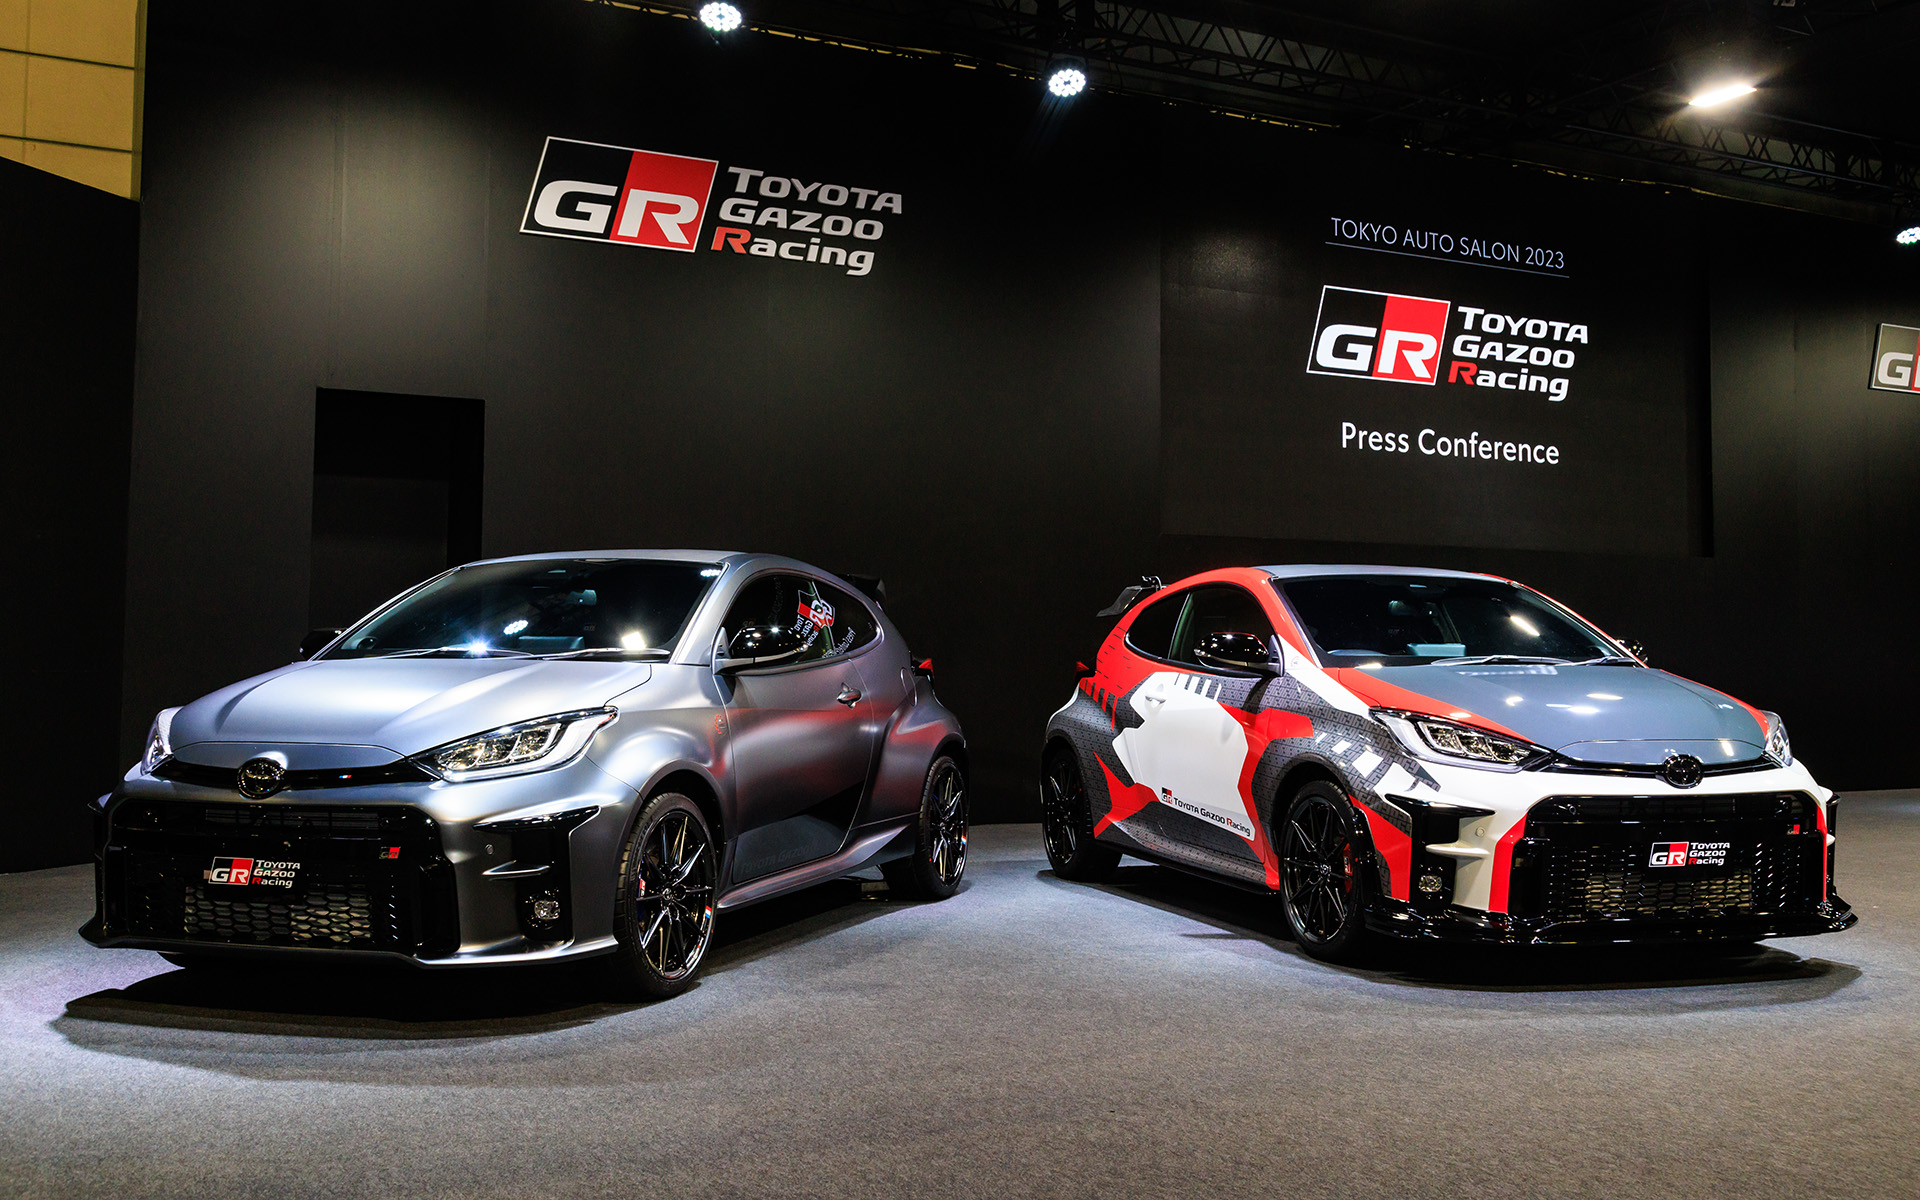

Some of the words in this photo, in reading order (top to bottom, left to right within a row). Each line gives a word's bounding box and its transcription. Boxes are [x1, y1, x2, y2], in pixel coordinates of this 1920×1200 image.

[728, 167, 902, 214] TOYOTA
[534, 180, 699, 244] GR
[719, 198, 884, 241] GAZOO
[710, 226, 875, 276] Racing
[1331, 218, 1397, 244] TOKYO
[1403, 229, 1454, 252] AUTO
[1460, 237, 1519, 263] SALON
[1525, 247, 1564, 269] 2023
[1458, 306, 1589, 344] TOYOTA
[1316, 324, 1438, 378] GR
[1453, 335, 1575, 368] GAZOO
[1448, 360, 1569, 402] Racing
[1342, 422, 1409, 453] Press
[1418, 429, 1559, 464] Conference
[1173, 797, 1199, 814] TOYOTA
[1200, 808, 1225, 824] GAZOO
[1227, 818, 1250, 836] Racing
[211, 868, 249, 883] GR
[253, 869, 295, 878] GAZOO
[256, 860, 300, 869] TOYOTA
[1651, 852, 1685, 865] GR
[1688, 857, 1724, 866] Racing
[252, 877, 293, 888] Racing
